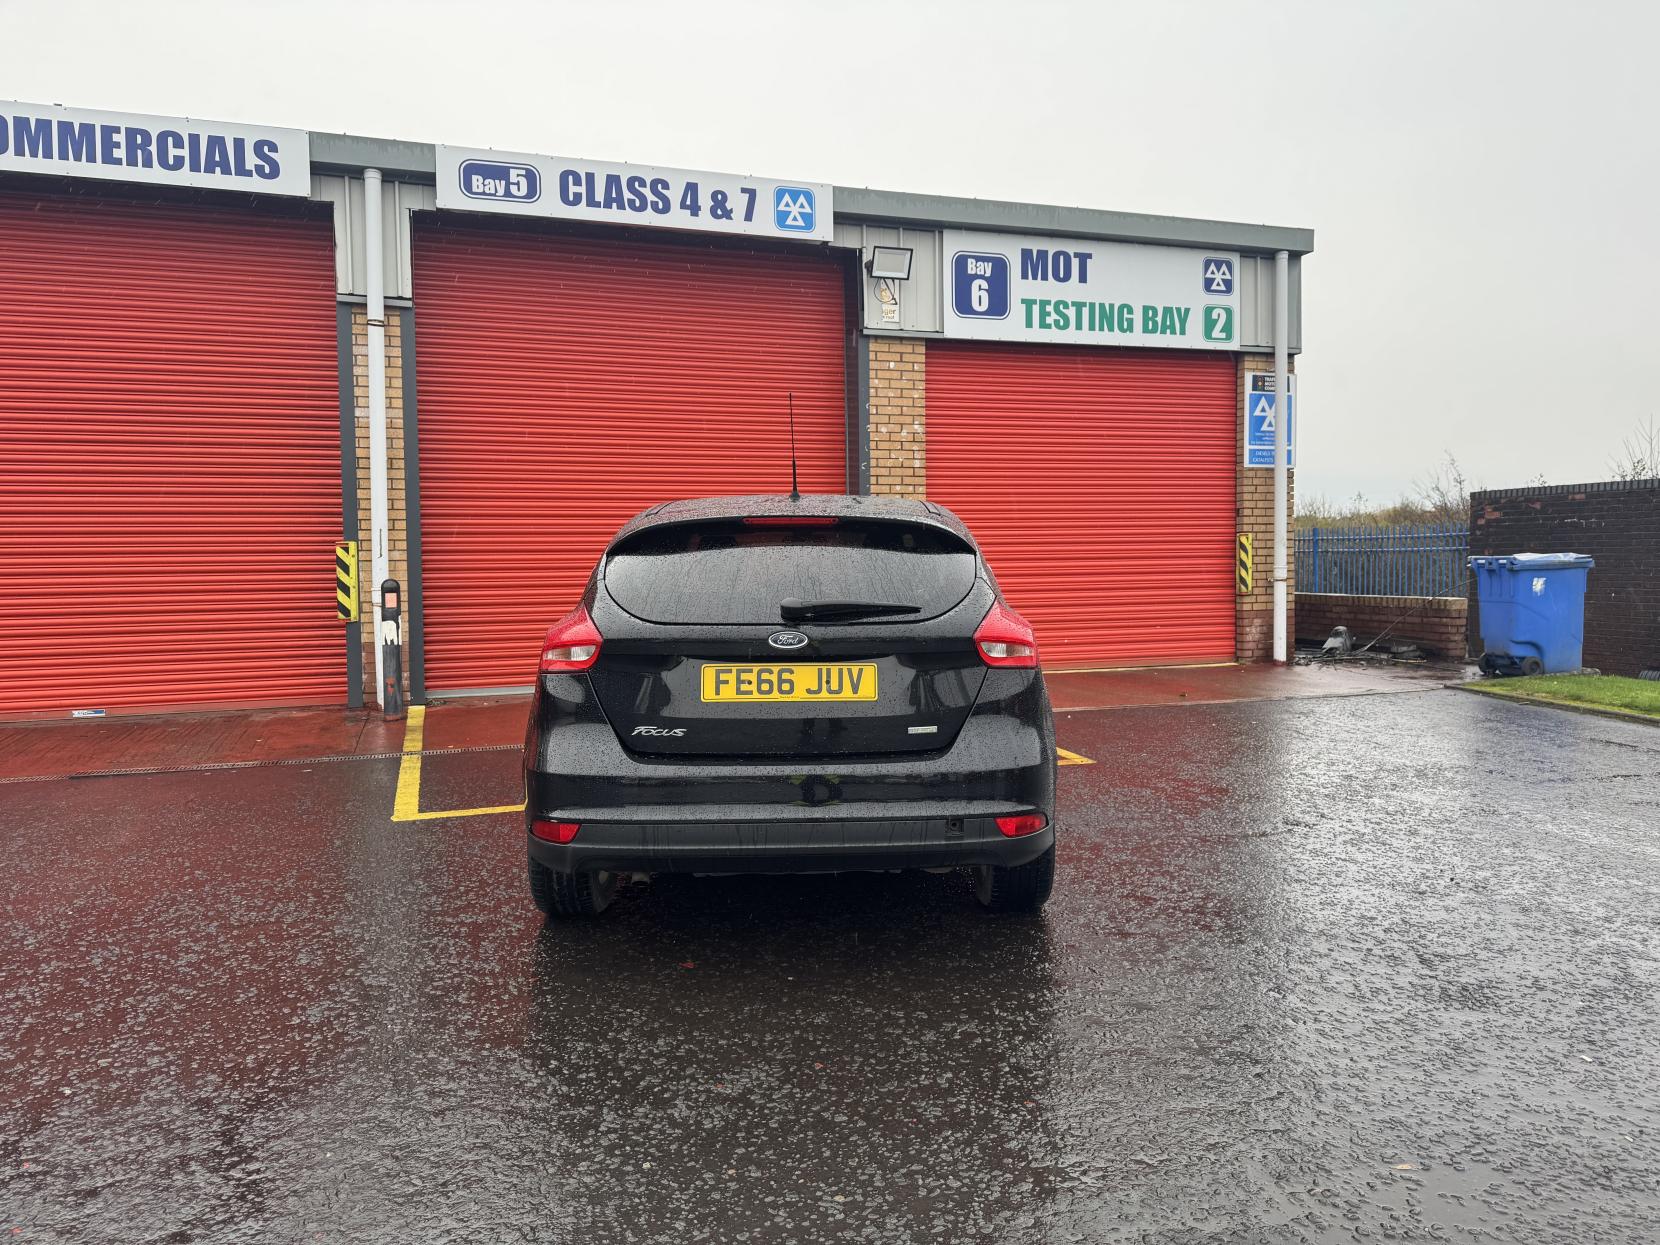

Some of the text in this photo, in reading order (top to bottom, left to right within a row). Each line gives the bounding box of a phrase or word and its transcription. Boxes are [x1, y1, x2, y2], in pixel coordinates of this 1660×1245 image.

[0, 115, 281, 180] MMERCIALS
[471, 168, 528, 197] Bay 5
[559, 169, 757, 222] CLASS 4 & 7
[967, 258, 992, 278] Bay
[1020, 248, 1093, 284] MOT
[970, 278, 989, 313] 6
[1020, 298, 1191, 336] TESTING BAY
[1209, 308, 1227, 339] 2
[777, 635, 799, 645] Ford
[714, 667, 864, 696] FE66 JUV
